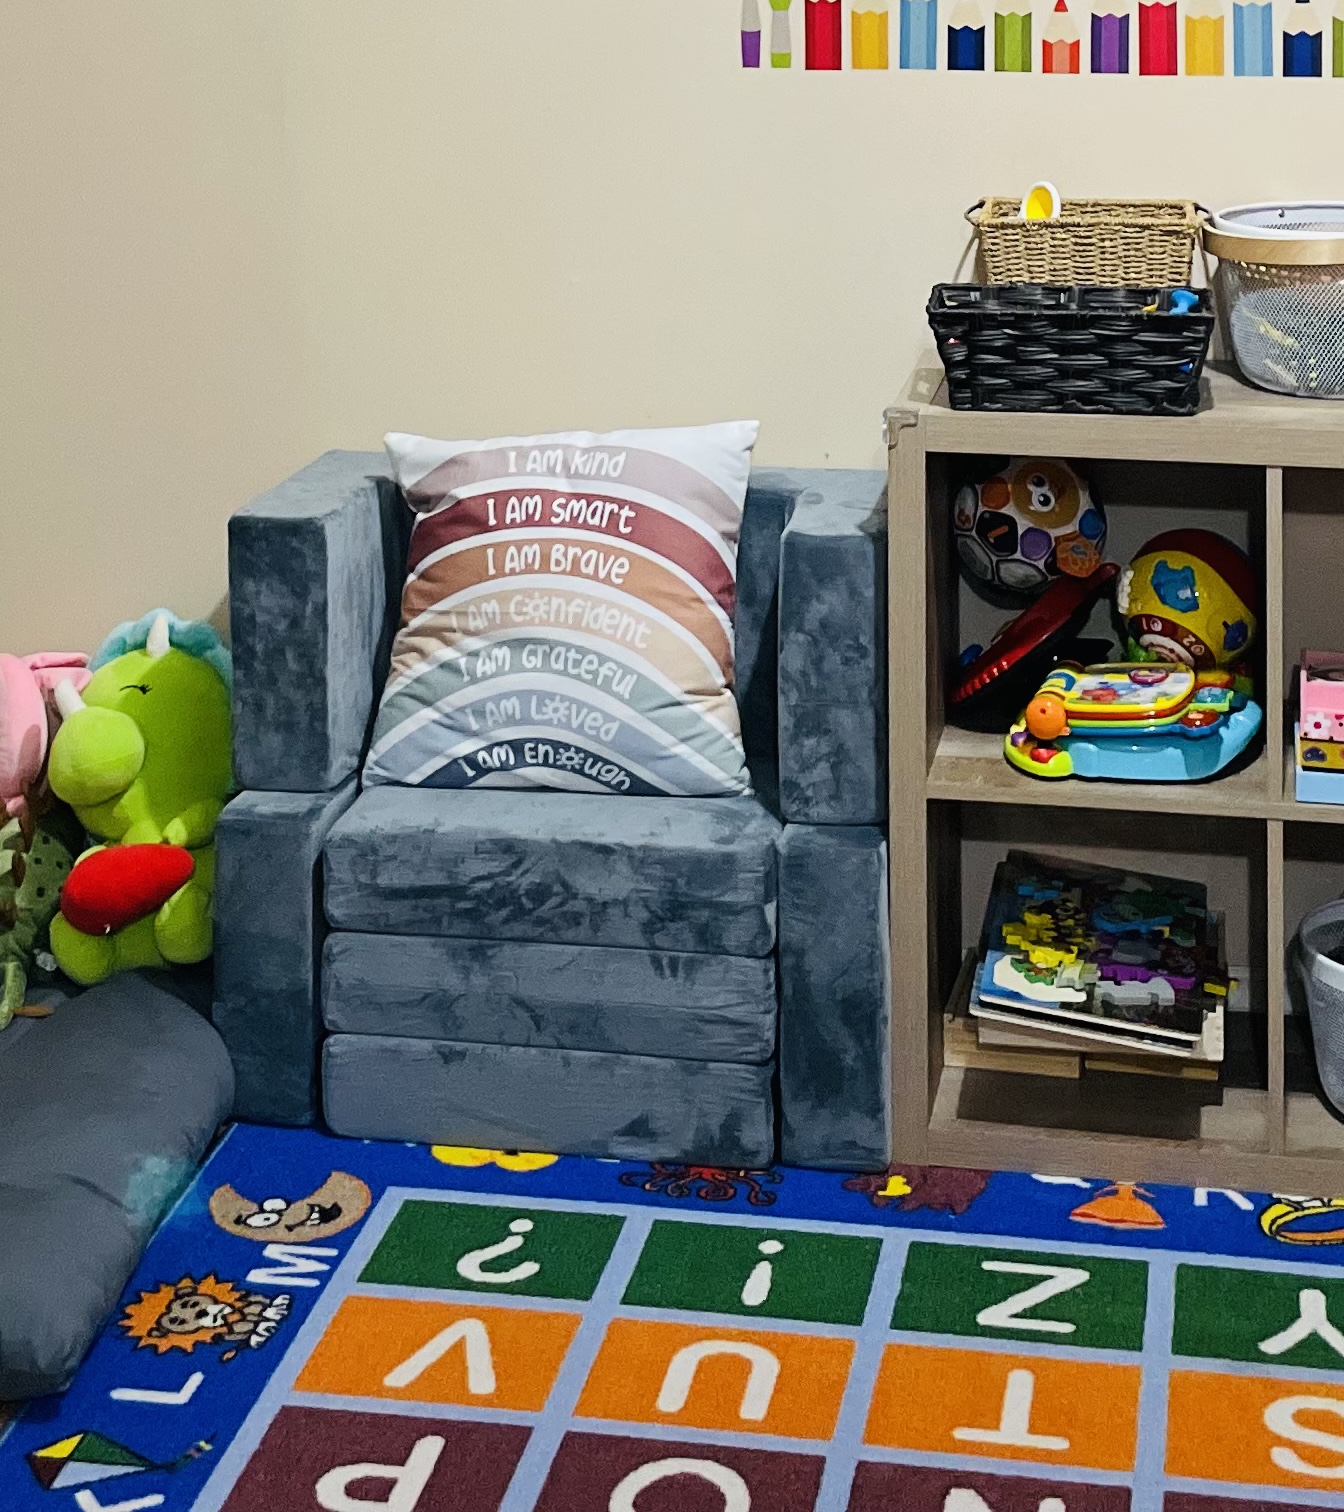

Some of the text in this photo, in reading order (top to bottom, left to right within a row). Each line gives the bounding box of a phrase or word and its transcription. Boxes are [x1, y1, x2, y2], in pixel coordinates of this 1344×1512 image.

[507, 451, 518, 473] I
[526, 449, 564, 474] AM
[486, 498, 497, 526] I
[505, 494, 543, 525] AM
[486, 543, 631, 585] I AM Brave
[468, 599, 501, 631] AM
[509, 591, 652, 649] Confident
[459, 643, 639, 700] I AM Grateful
[464, 694, 621, 743] I AM Loved
[457, 742, 631, 791] I AM Enough
[975, 1260, 1091, 1334] Z
[383, 1318, 497, 1395] V
[656, 1339, 782, 1422] U
[952, 1369, 1071, 1451] T
